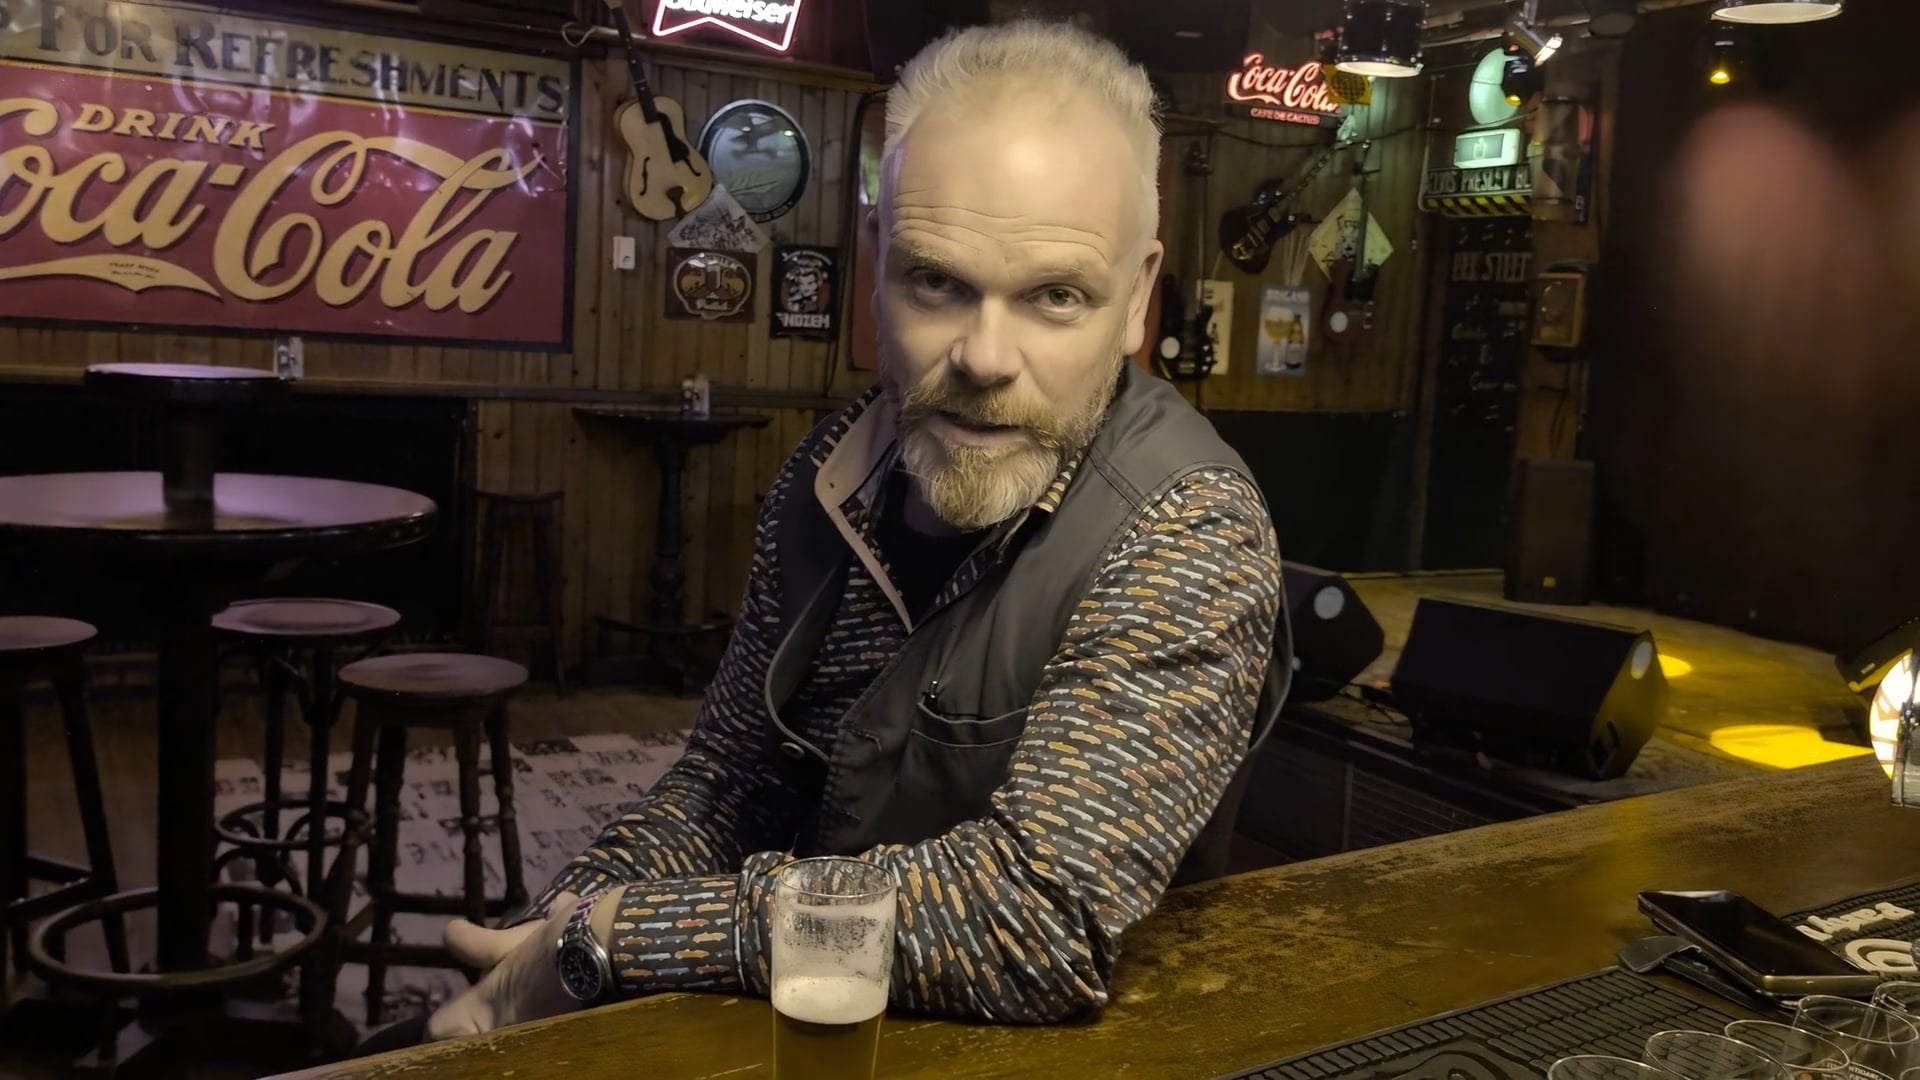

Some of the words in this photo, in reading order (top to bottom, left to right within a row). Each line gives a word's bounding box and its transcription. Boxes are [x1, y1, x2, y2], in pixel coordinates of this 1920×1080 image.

[174, 17, 564, 113] REFRESHMENTS
[71, 103, 276, 150] DRINK
[1460, 167, 1511, 192] PRESLEY
[0, 98, 547, 314] oca-Cola
[782, 312, 831, 329] NOZEM
